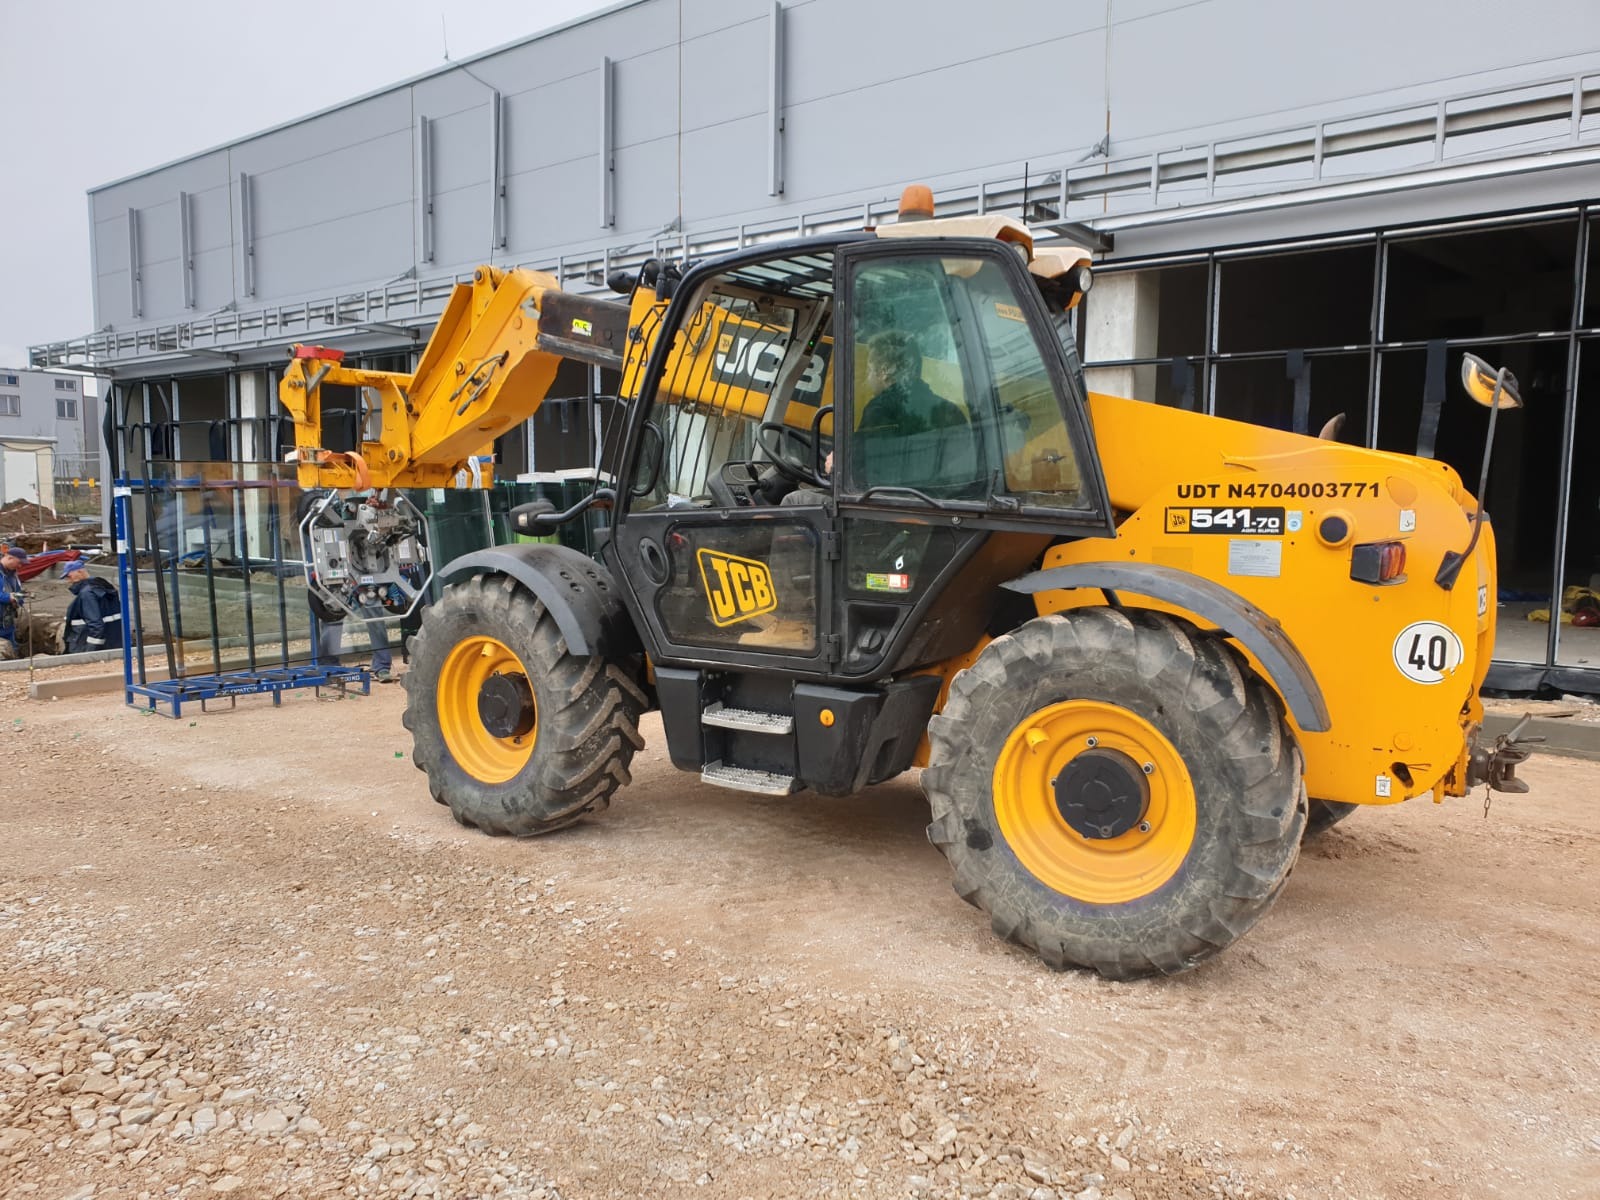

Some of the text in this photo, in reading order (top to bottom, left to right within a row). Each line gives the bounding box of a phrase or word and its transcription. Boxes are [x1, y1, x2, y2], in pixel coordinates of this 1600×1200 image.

[716, 337, 825, 393] JCB
[1177, 482, 1379, 498] UDT N4704003771
[1191, 508, 1280, 528] 541-70
[710, 557, 771, 618] JCB
[1408, 633, 1447, 671] 40
